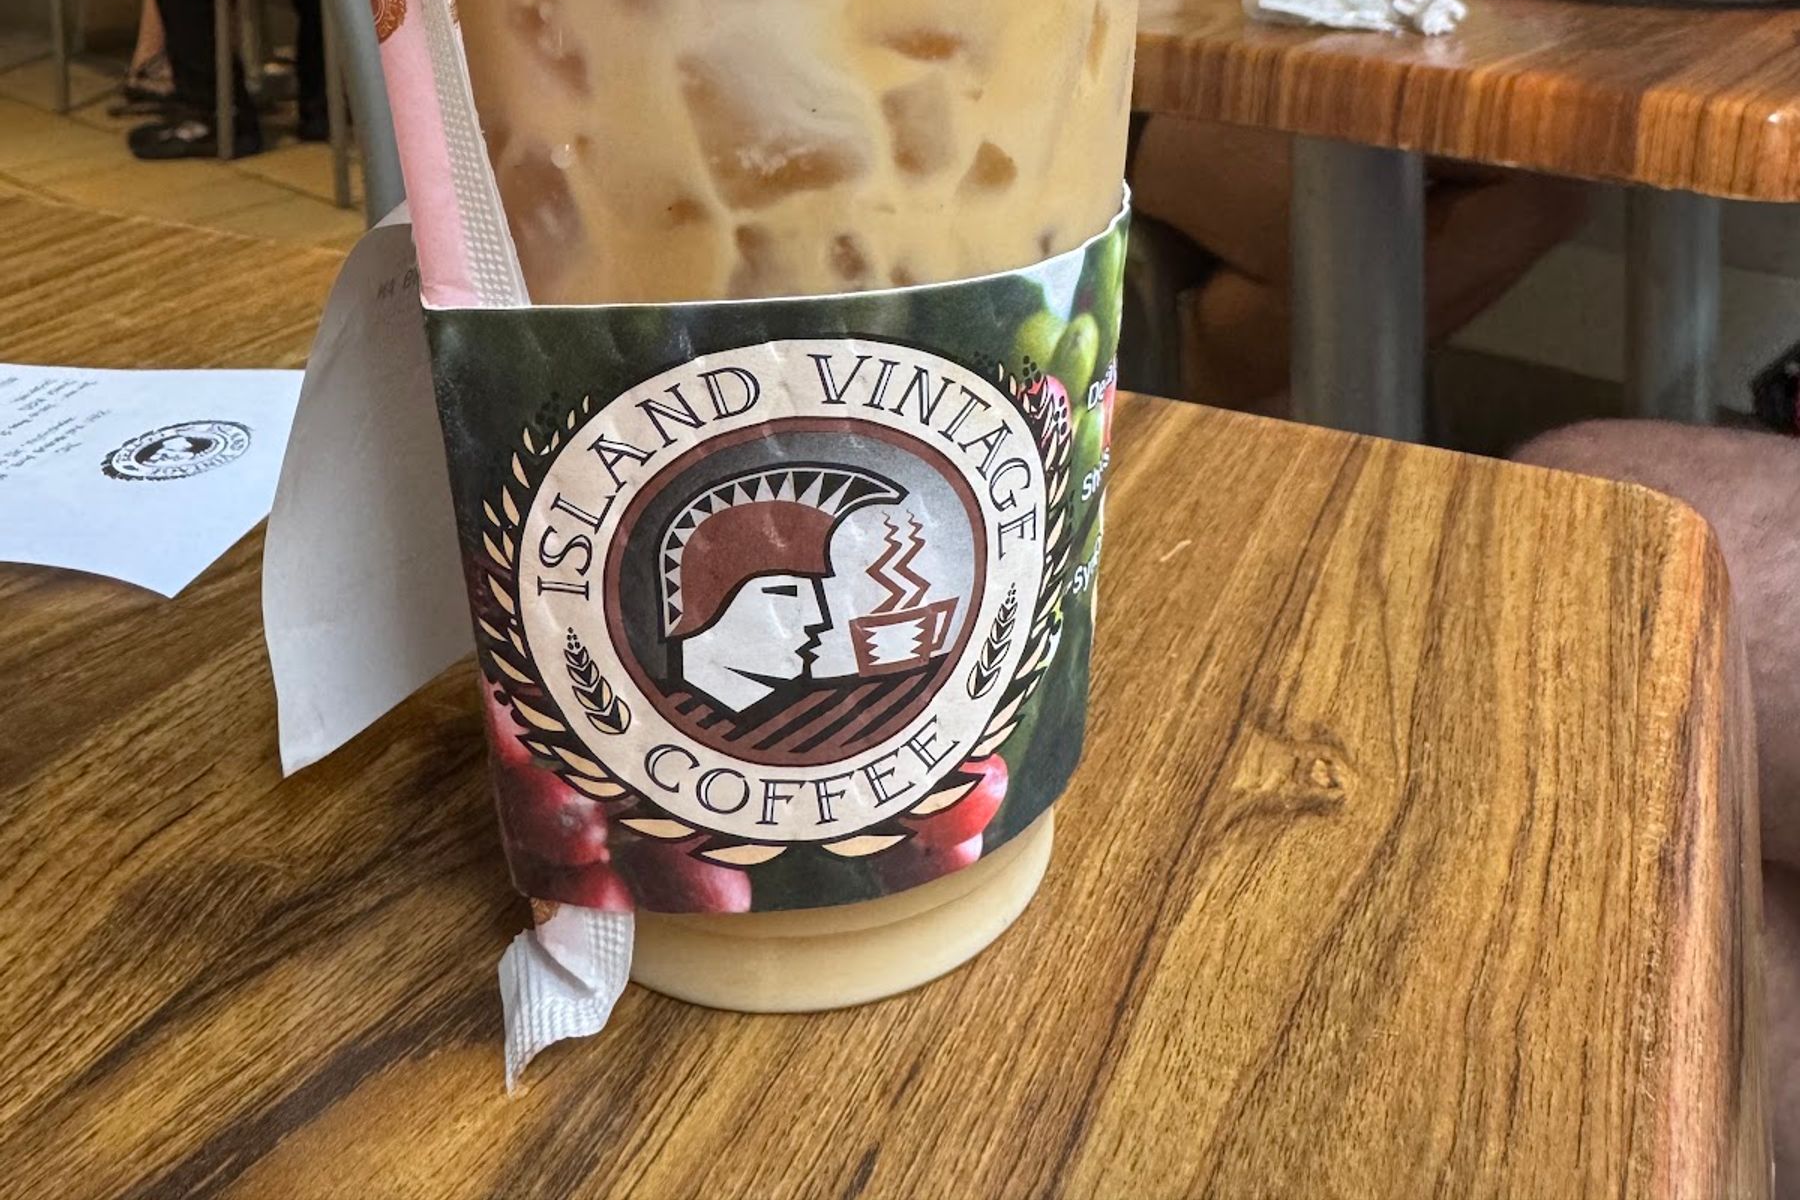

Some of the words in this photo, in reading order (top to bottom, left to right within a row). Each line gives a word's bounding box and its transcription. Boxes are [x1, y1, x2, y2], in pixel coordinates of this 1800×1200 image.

[536, 365, 763, 601] ISLAND
[806, 351, 1041, 559] VINTAGE
[643, 714, 962, 828] COFFEE
